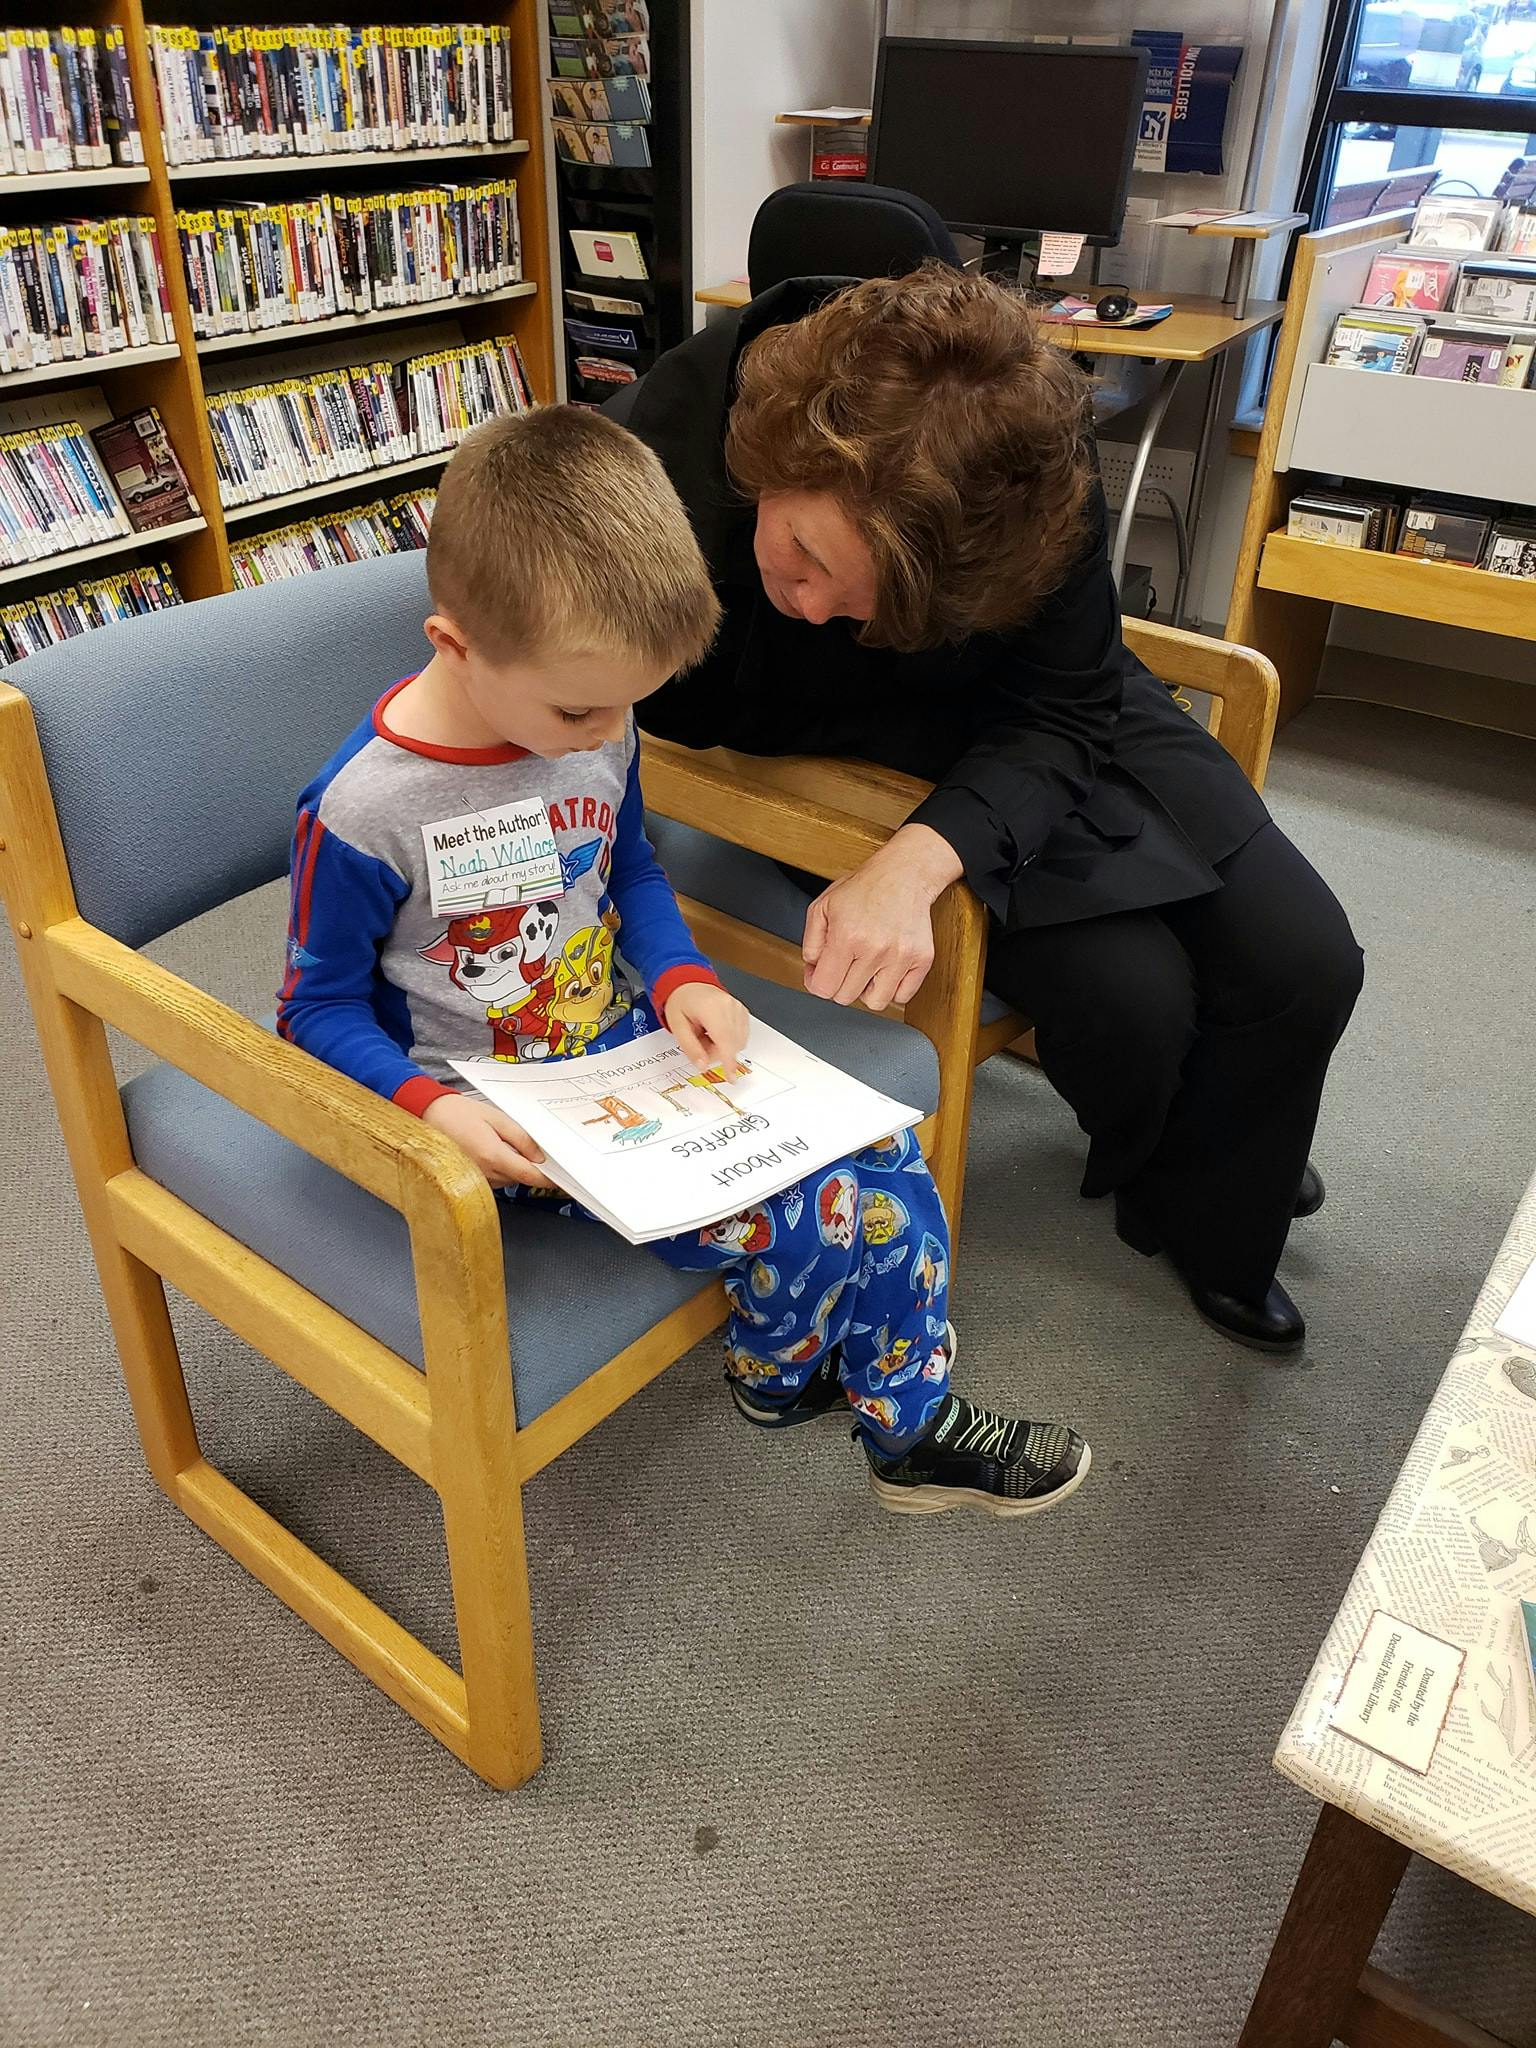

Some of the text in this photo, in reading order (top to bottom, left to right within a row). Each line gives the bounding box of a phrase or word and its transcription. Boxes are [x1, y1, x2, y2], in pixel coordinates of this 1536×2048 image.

[1173, 62, 1196, 120] COLLEGES
[241, 246, 250, 277] SUPER
[82, 460, 105, 499] NOAH
[433, 808, 548, 851] Meet the Author!
[550, 796, 614, 840] ATROL
[440, 835, 556, 879] Noah Wallace
[442, 880, 461, 894] Ask
[464, 878, 480, 890] me
[481, 871, 509, 887] about
[512, 870, 527, 884] my
[711, 1136, 809, 1187] All About
[1358, 1633, 1402, 1724] Deerfield Public Library
[1388, 1660, 1414, 1713] Friends of the
[1407, 1668, 1435, 1727] Donated by the
